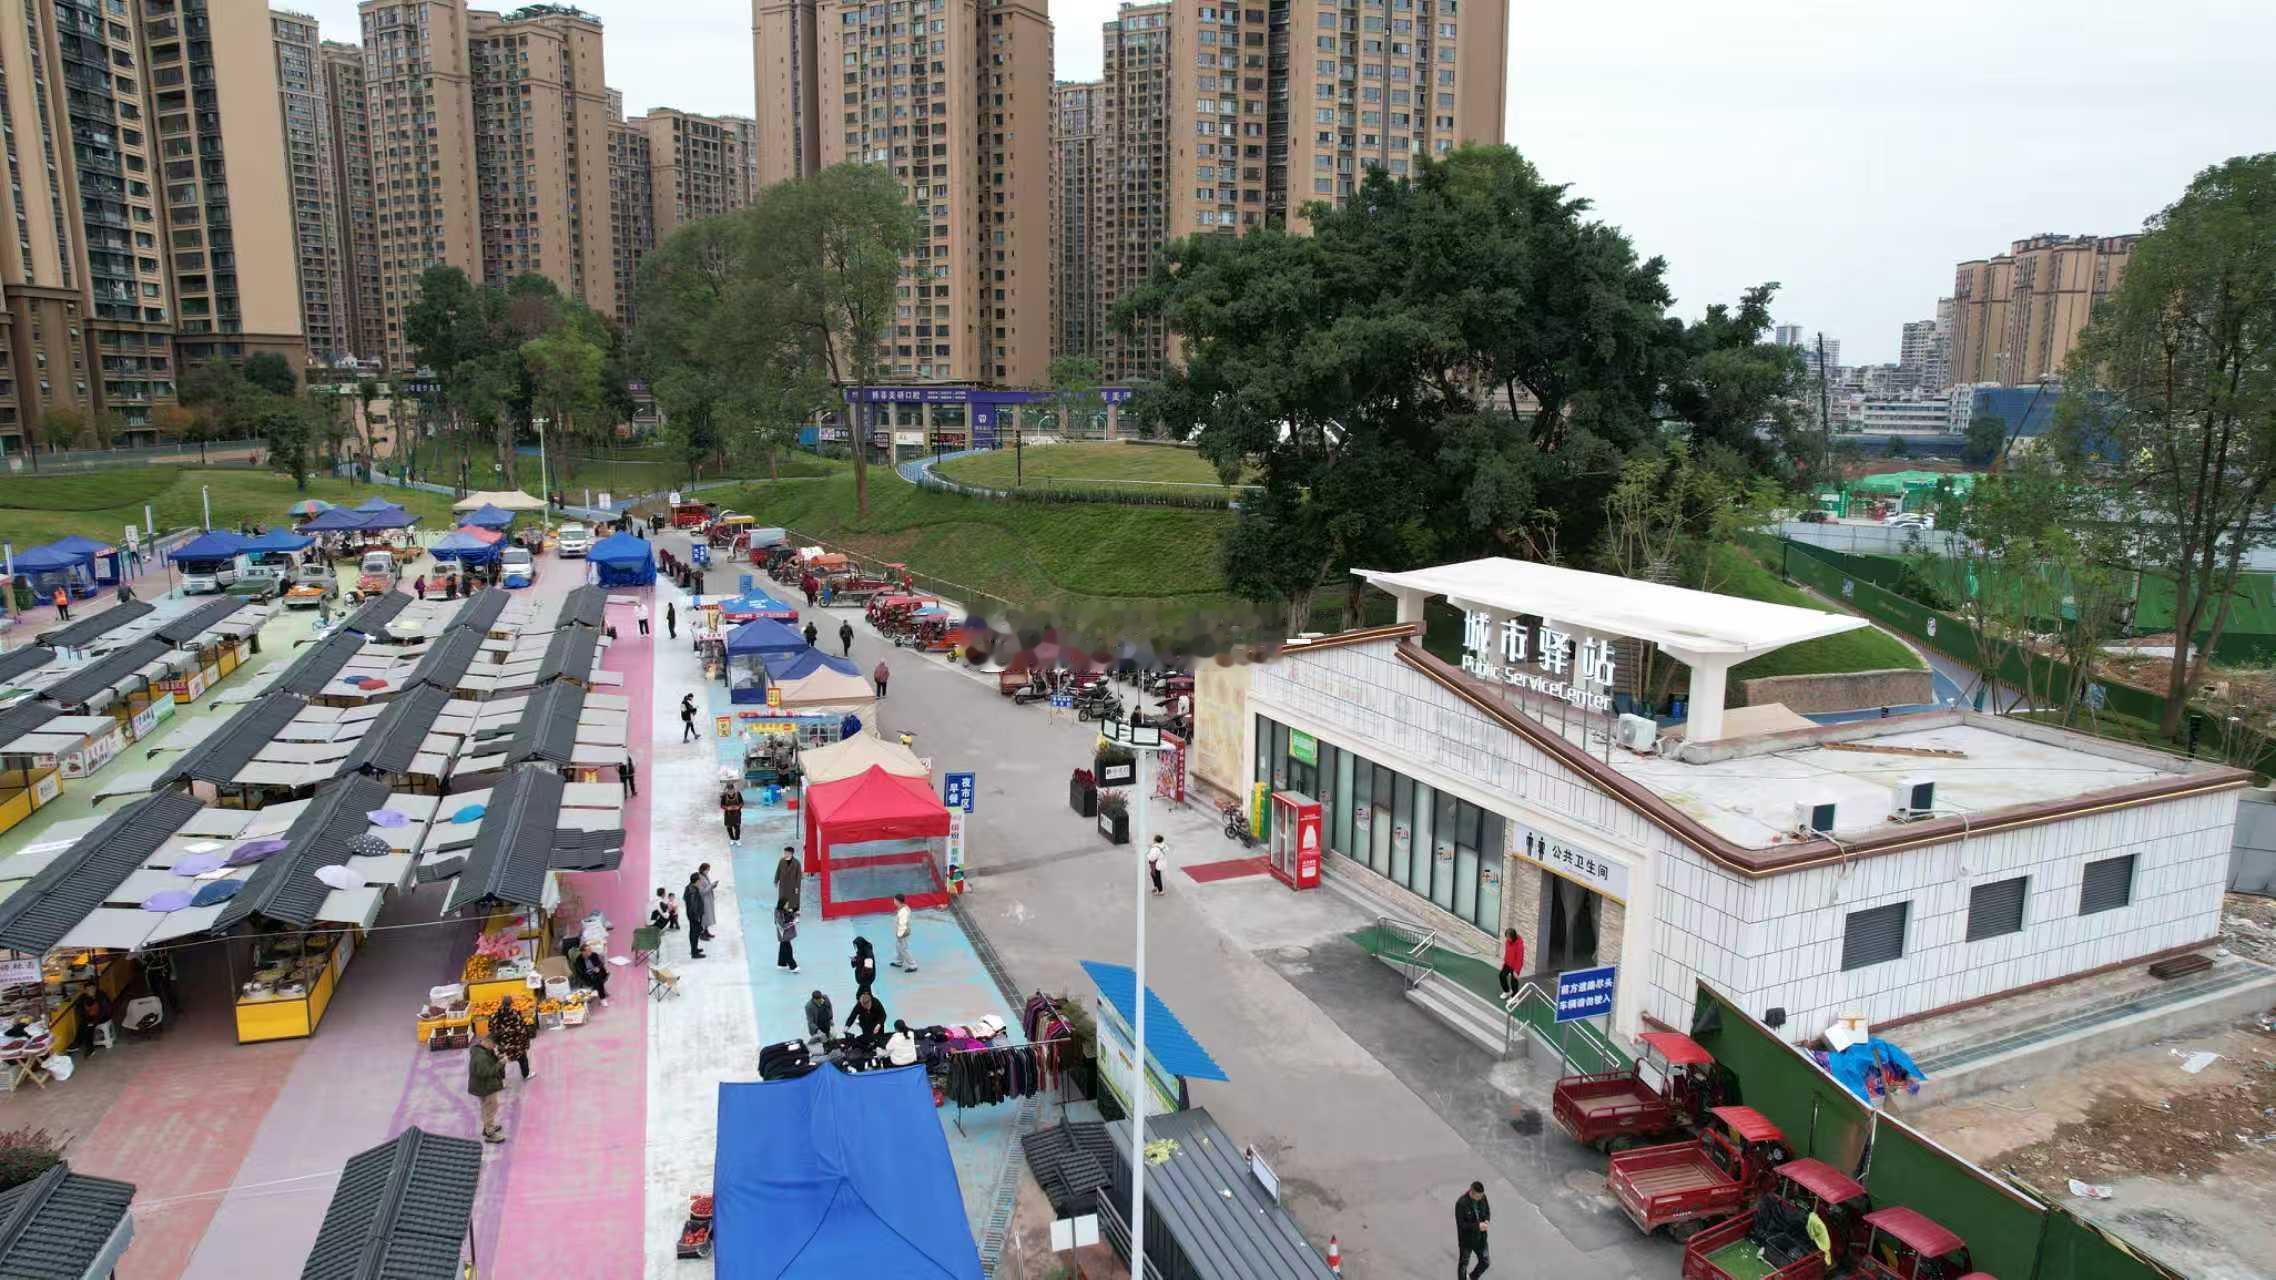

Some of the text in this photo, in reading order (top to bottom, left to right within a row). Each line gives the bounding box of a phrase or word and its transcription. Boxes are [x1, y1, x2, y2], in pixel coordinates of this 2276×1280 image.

[1462, 609, 1616, 686] 城市驿站
[1462, 655, 1500, 680] Public
[1552, 845, 1609, 881] 公共卫生间
